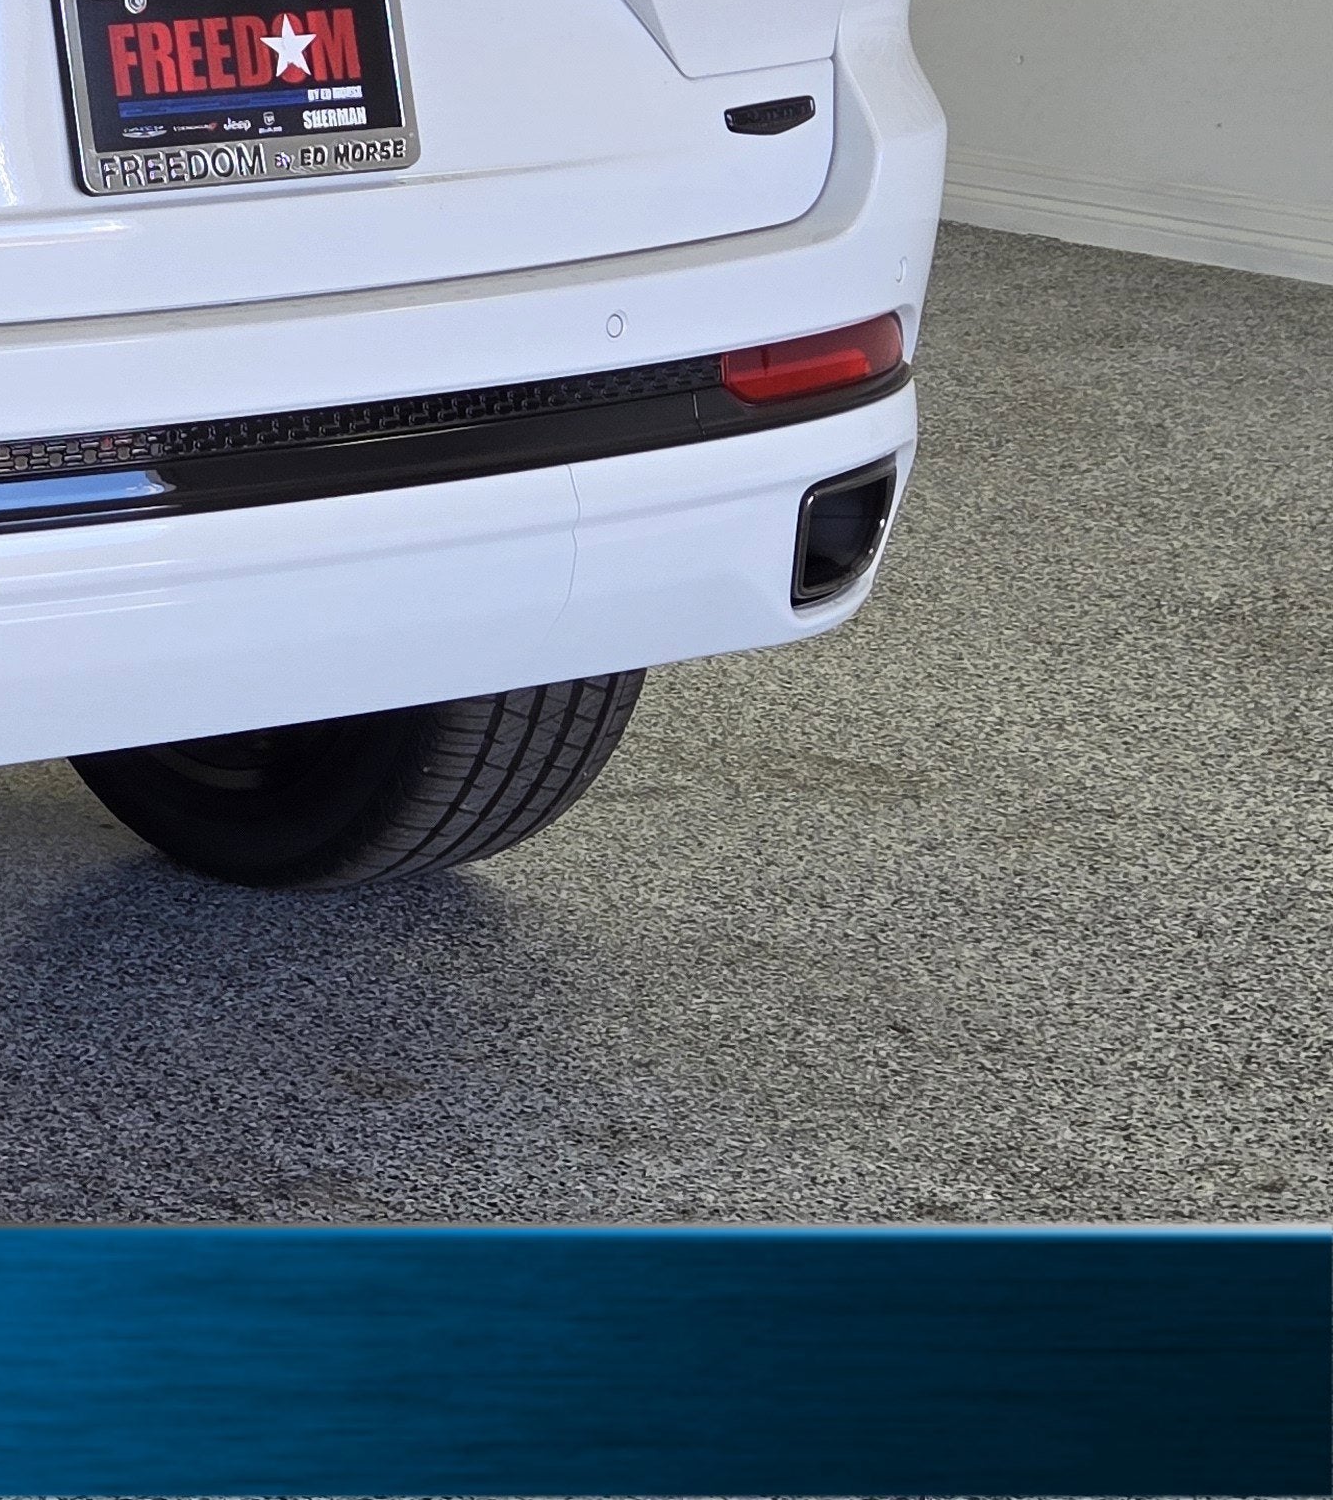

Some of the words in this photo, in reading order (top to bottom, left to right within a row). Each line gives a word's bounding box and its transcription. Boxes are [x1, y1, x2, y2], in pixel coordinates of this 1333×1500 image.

[107, 8, 362, 98] FREEDOM
[223, 116, 252, 132] Jeep
[302, 106, 367, 130] SHERMAN
[99, 142, 267, 190] FREEDOM
[300, 144, 329, 167] ED
[334, 137, 407, 167] MORSE
